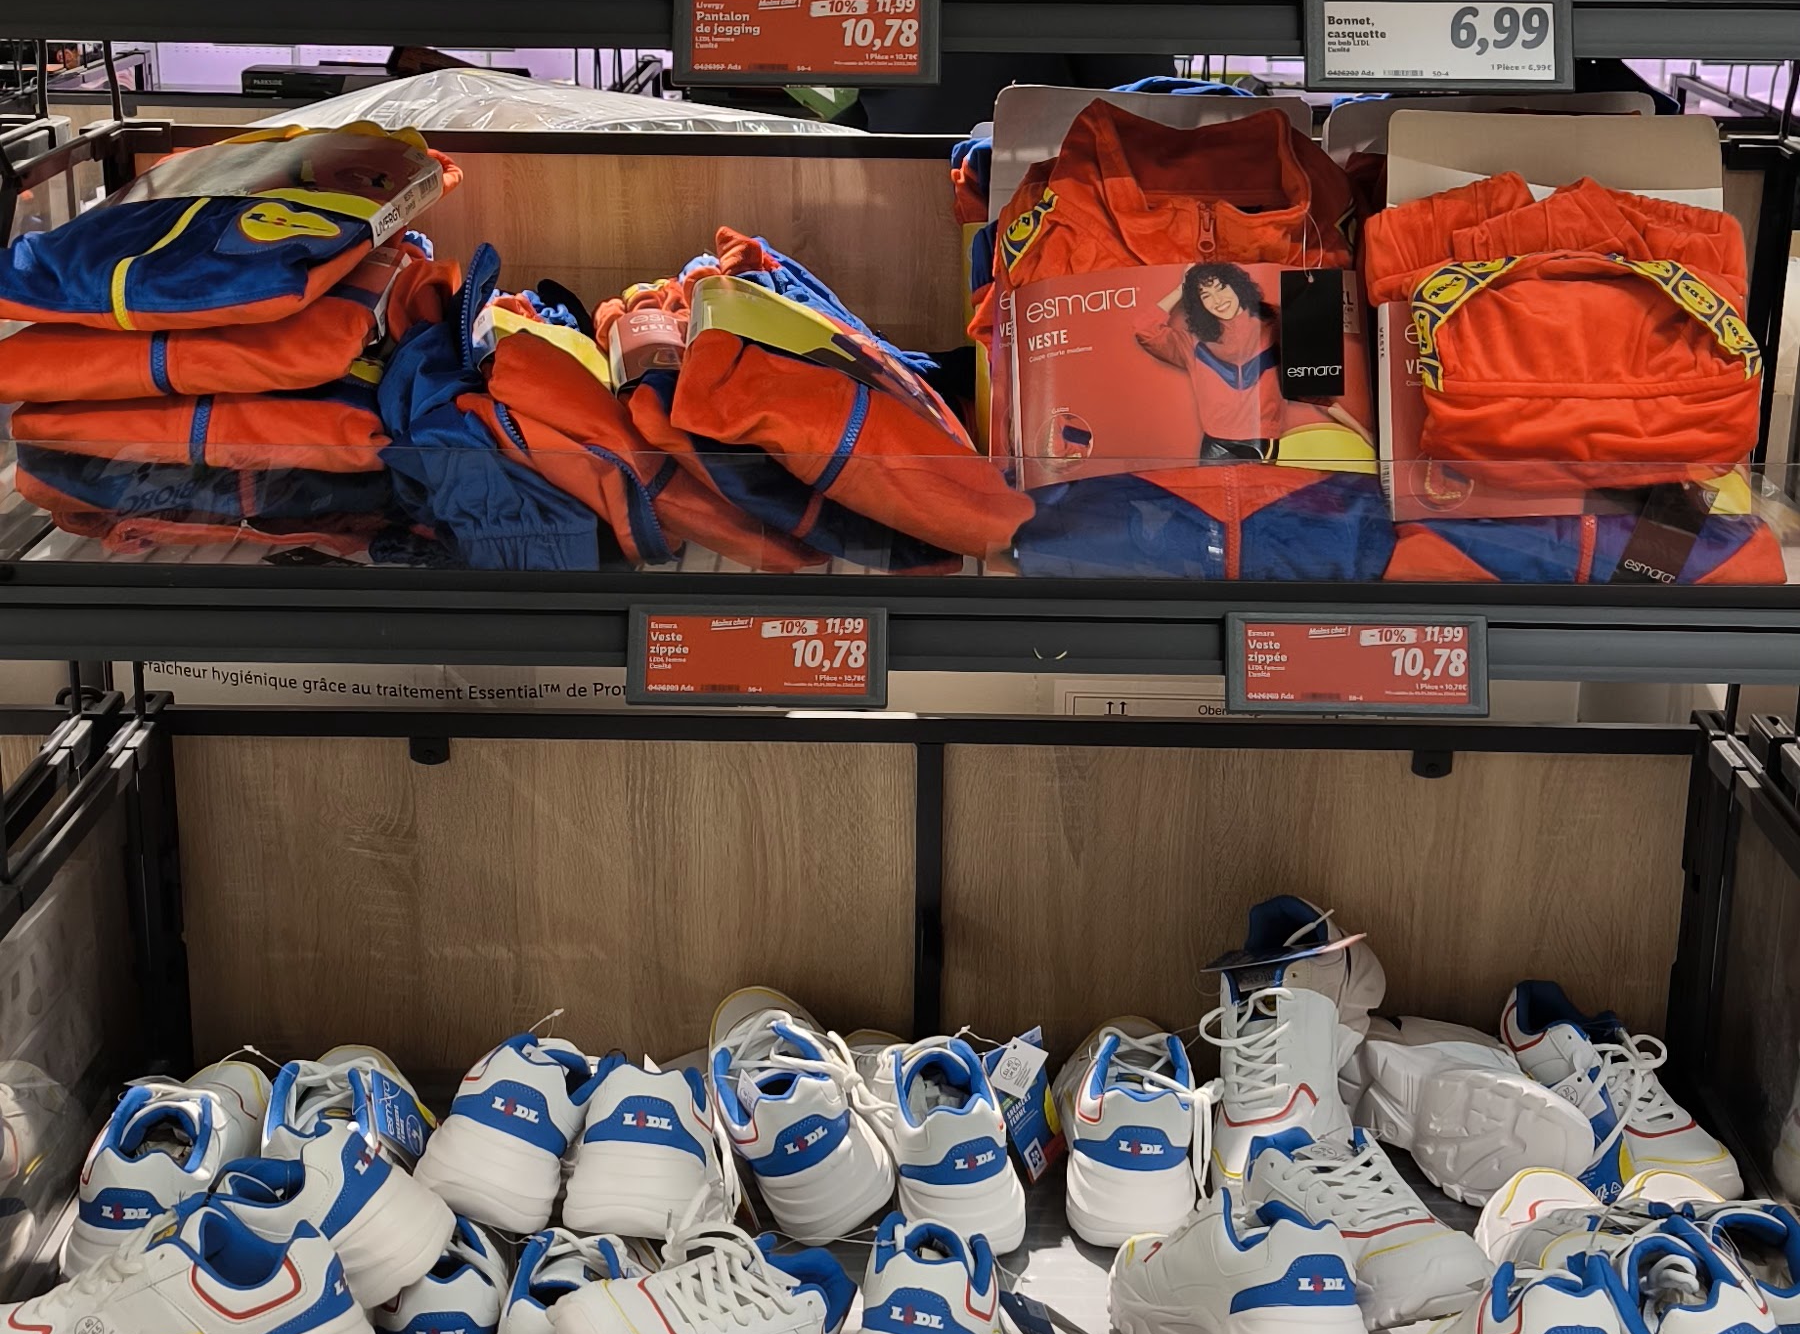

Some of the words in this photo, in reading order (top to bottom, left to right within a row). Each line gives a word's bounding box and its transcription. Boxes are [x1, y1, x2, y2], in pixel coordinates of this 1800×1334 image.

[696, 1, 725, 11] Livergy
[820, 0, 859, 14] -10%
[696, 11, 750, 22] Pantalon
[1327, 15, 1376, 27] Bonnet,
[695, 23, 711, 34] de
[713, 22, 761, 36] jogging
[841, 17, 919, 51] 10,78
[1327, 29, 1387, 41] casquette
[1450, 5, 1550, 57] 6,99
[1353, 39, 1370, 47] LIDL
[1496, 63, 1520, 71] Pièce
[632, 323, 674, 333] VESTE
[1028, 329, 1069, 352] VESTE
[770, 620, 807, 635] -10%
[824, 617, 865, 635] 11,99
[1423, 625, 1464, 643] 11,99
[650, 631, 683, 642] Veste
[1247, 639, 1281, 650] Veste
[1369, 628, 1407, 643] -10%
[649, 644, 689, 656] zippée
[791, 639, 867, 672] 10,78
[1247, 651, 1288, 664] zippée
[1391, 647, 1468, 681] 10,78
[212, 666, 298, 691] hygiénique
[302, 676, 348, 696] grâce
[351, 681, 373, 696] au
[376, 681, 463, 701] traitement
[566, 681, 589, 698] de
[492, 1095, 540, 1125] LIDL
[622, 1110, 673, 1131] LIDL
[784, 1124, 829, 1156] LIDL
[1118, 1139, 1164, 1158] LIDL
[955, 1148, 997, 1171] LIDL
[101, 1203, 153, 1221] LIDL
[1297, 1274, 1347, 1293] LIDL
[890, 1303, 945, 1330] LIDL
